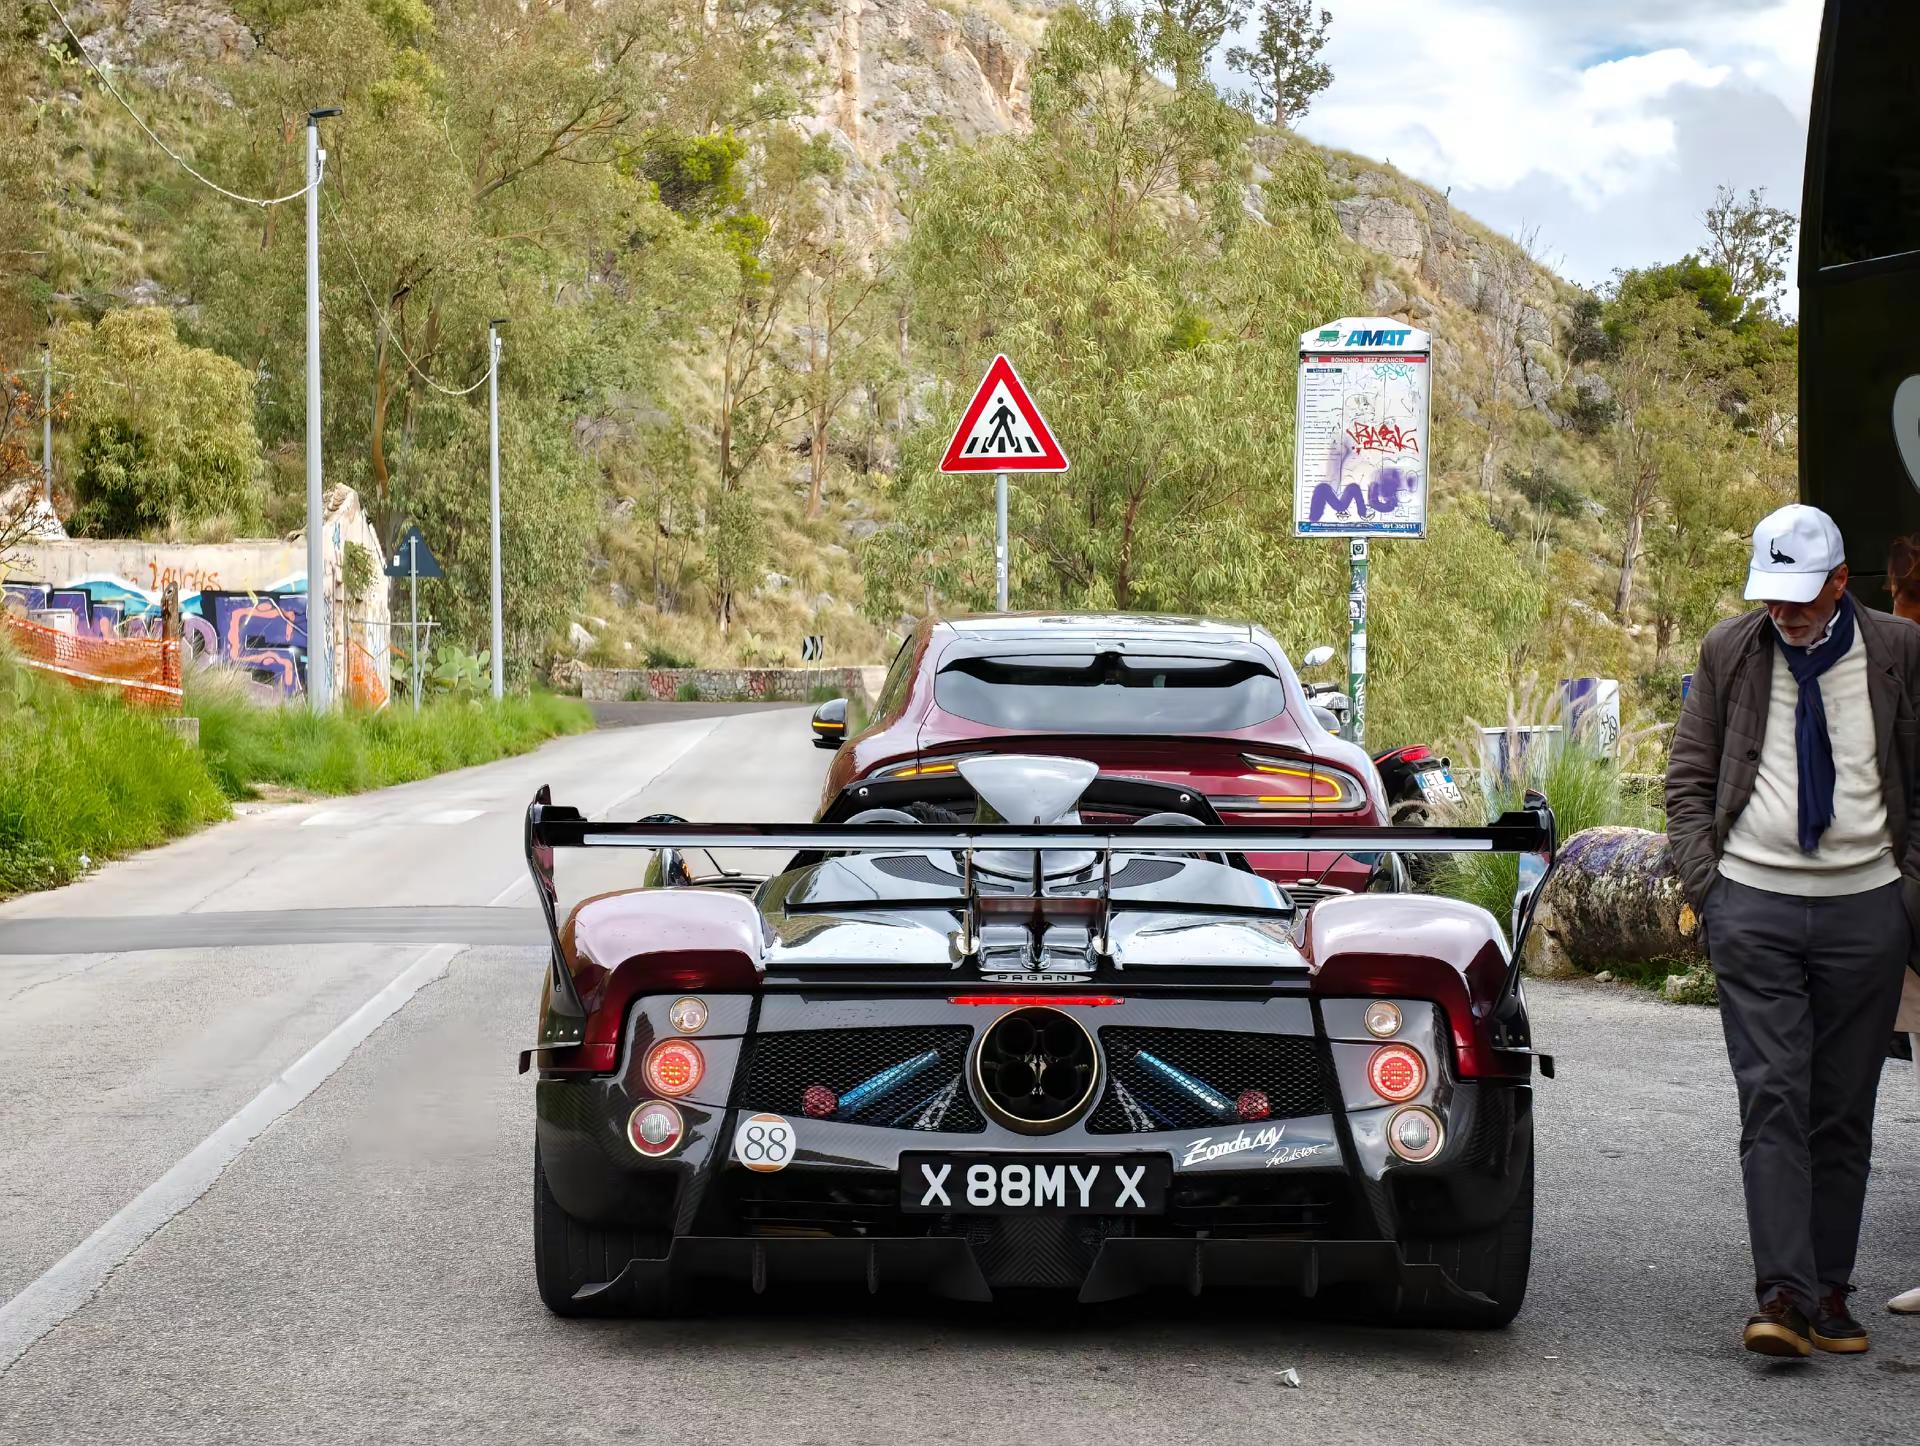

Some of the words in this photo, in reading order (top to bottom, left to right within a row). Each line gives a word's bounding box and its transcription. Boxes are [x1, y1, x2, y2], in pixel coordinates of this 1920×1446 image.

[1344, 330, 1412, 347] AMAT
[997, 974, 1076, 982] PAGANI
[744, 1126, 787, 1162] 88
[1182, 1129, 1251, 1167] Zonda
[920, 1164, 952, 1206] X
[966, 1164, 1100, 1207] 88MY
[1115, 1165, 1146, 1208] X
